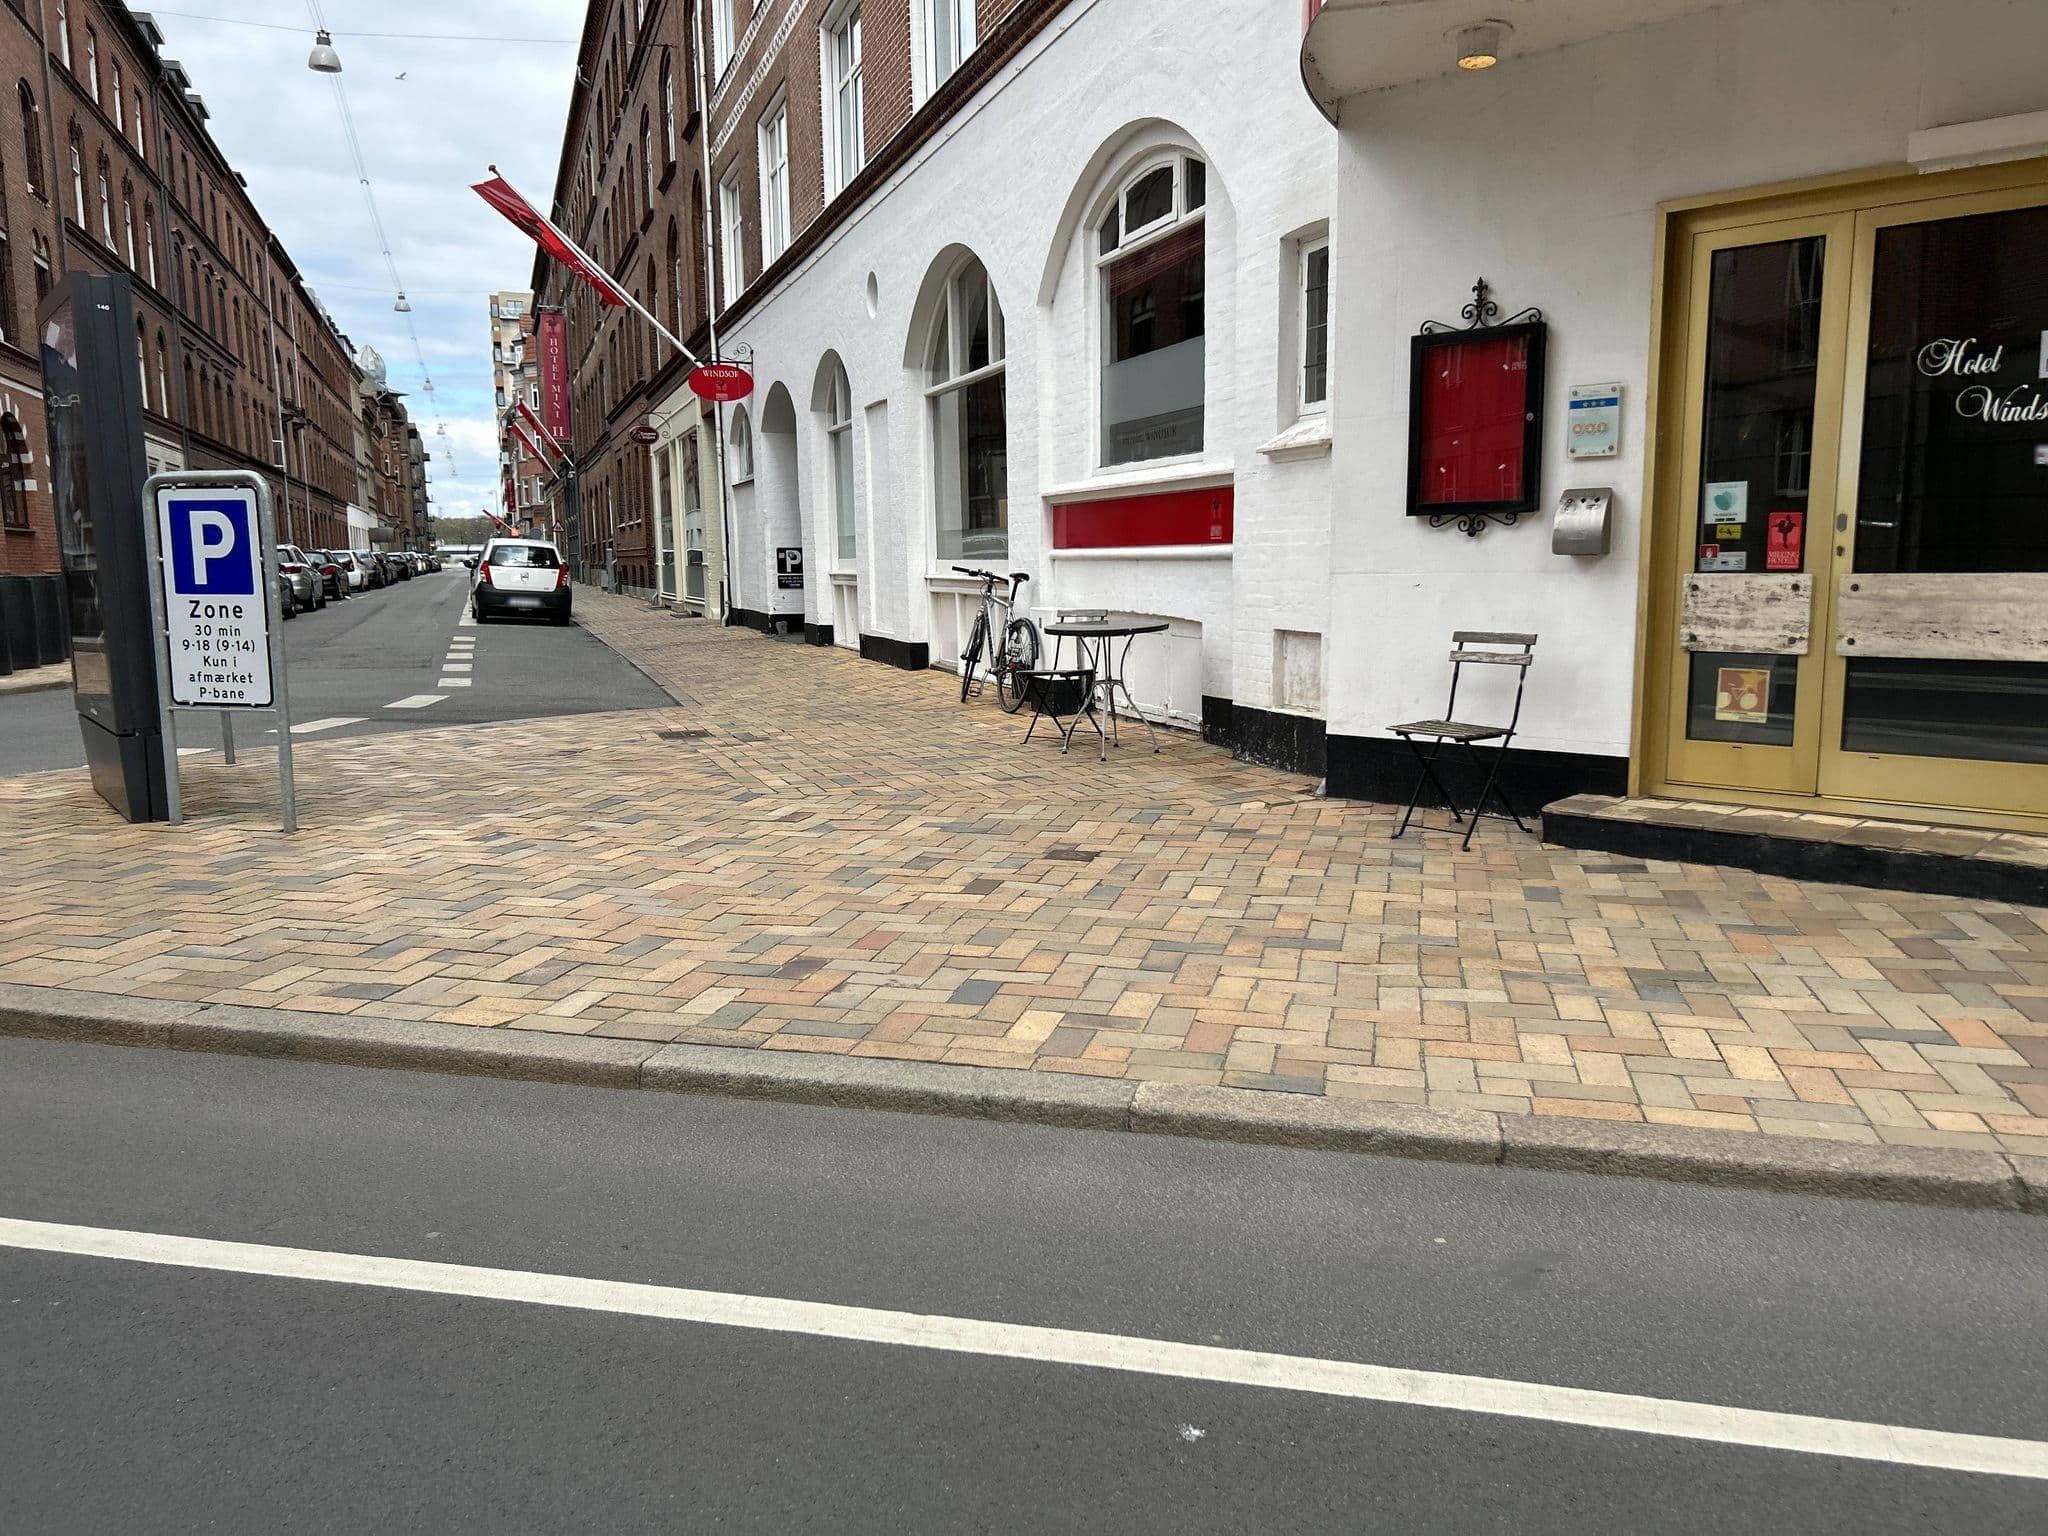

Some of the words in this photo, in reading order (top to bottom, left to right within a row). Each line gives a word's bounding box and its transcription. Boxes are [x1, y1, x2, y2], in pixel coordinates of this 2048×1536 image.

[549, 338, 559, 380] HOTEL
[1917, 338, 2003, 376] Hotel
[552, 384, 561, 418] MINI
[552, 426, 564, 437] II
[189, 510, 235, 585] P
[786, 550, 802, 572] P
[189, 600, 243, 619] Zone
[195, 625, 212, 637] 30
[218, 625, 241, 637] min
[182, 639, 210, 652] 9-18
[216, 639, 255, 653] (9-14)
[203, 656, 227, 668] Kun
[233, 656, 237, 668] i
[189, 672, 253, 684] afmærket
[200, 686, 245, 699] P-bane
